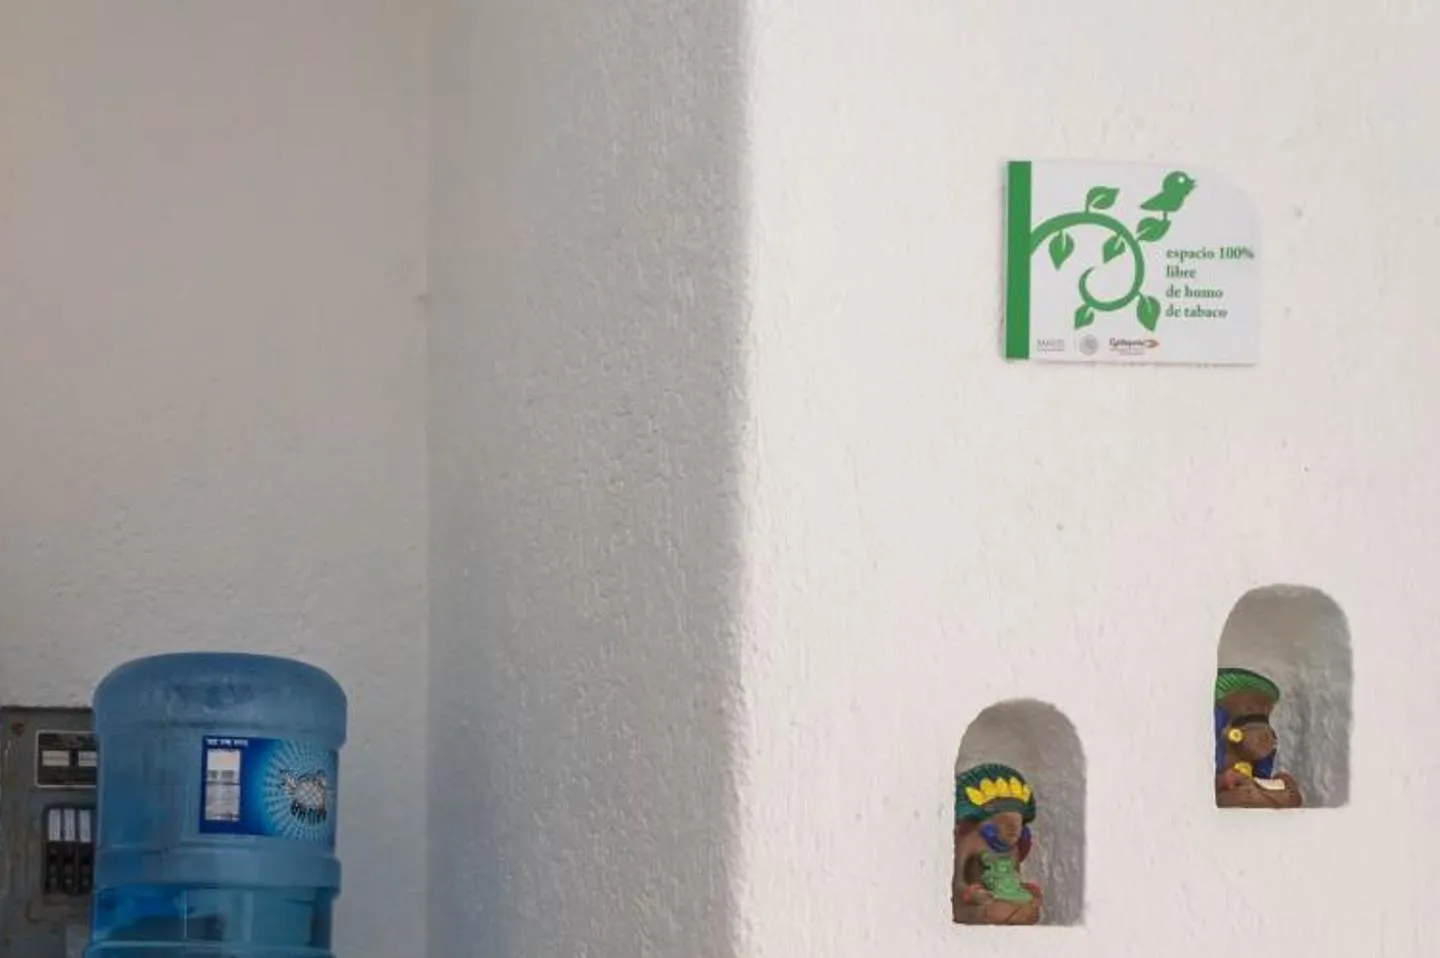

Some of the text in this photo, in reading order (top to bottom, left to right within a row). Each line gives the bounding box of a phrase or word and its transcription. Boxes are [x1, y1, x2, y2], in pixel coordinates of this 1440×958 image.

[1166, 246, 1254, 263] espacio 100%
[1166, 264, 1197, 278] libre
[1165, 284, 1224, 298] de humo
[1165, 303, 1228, 318] de tabaco
